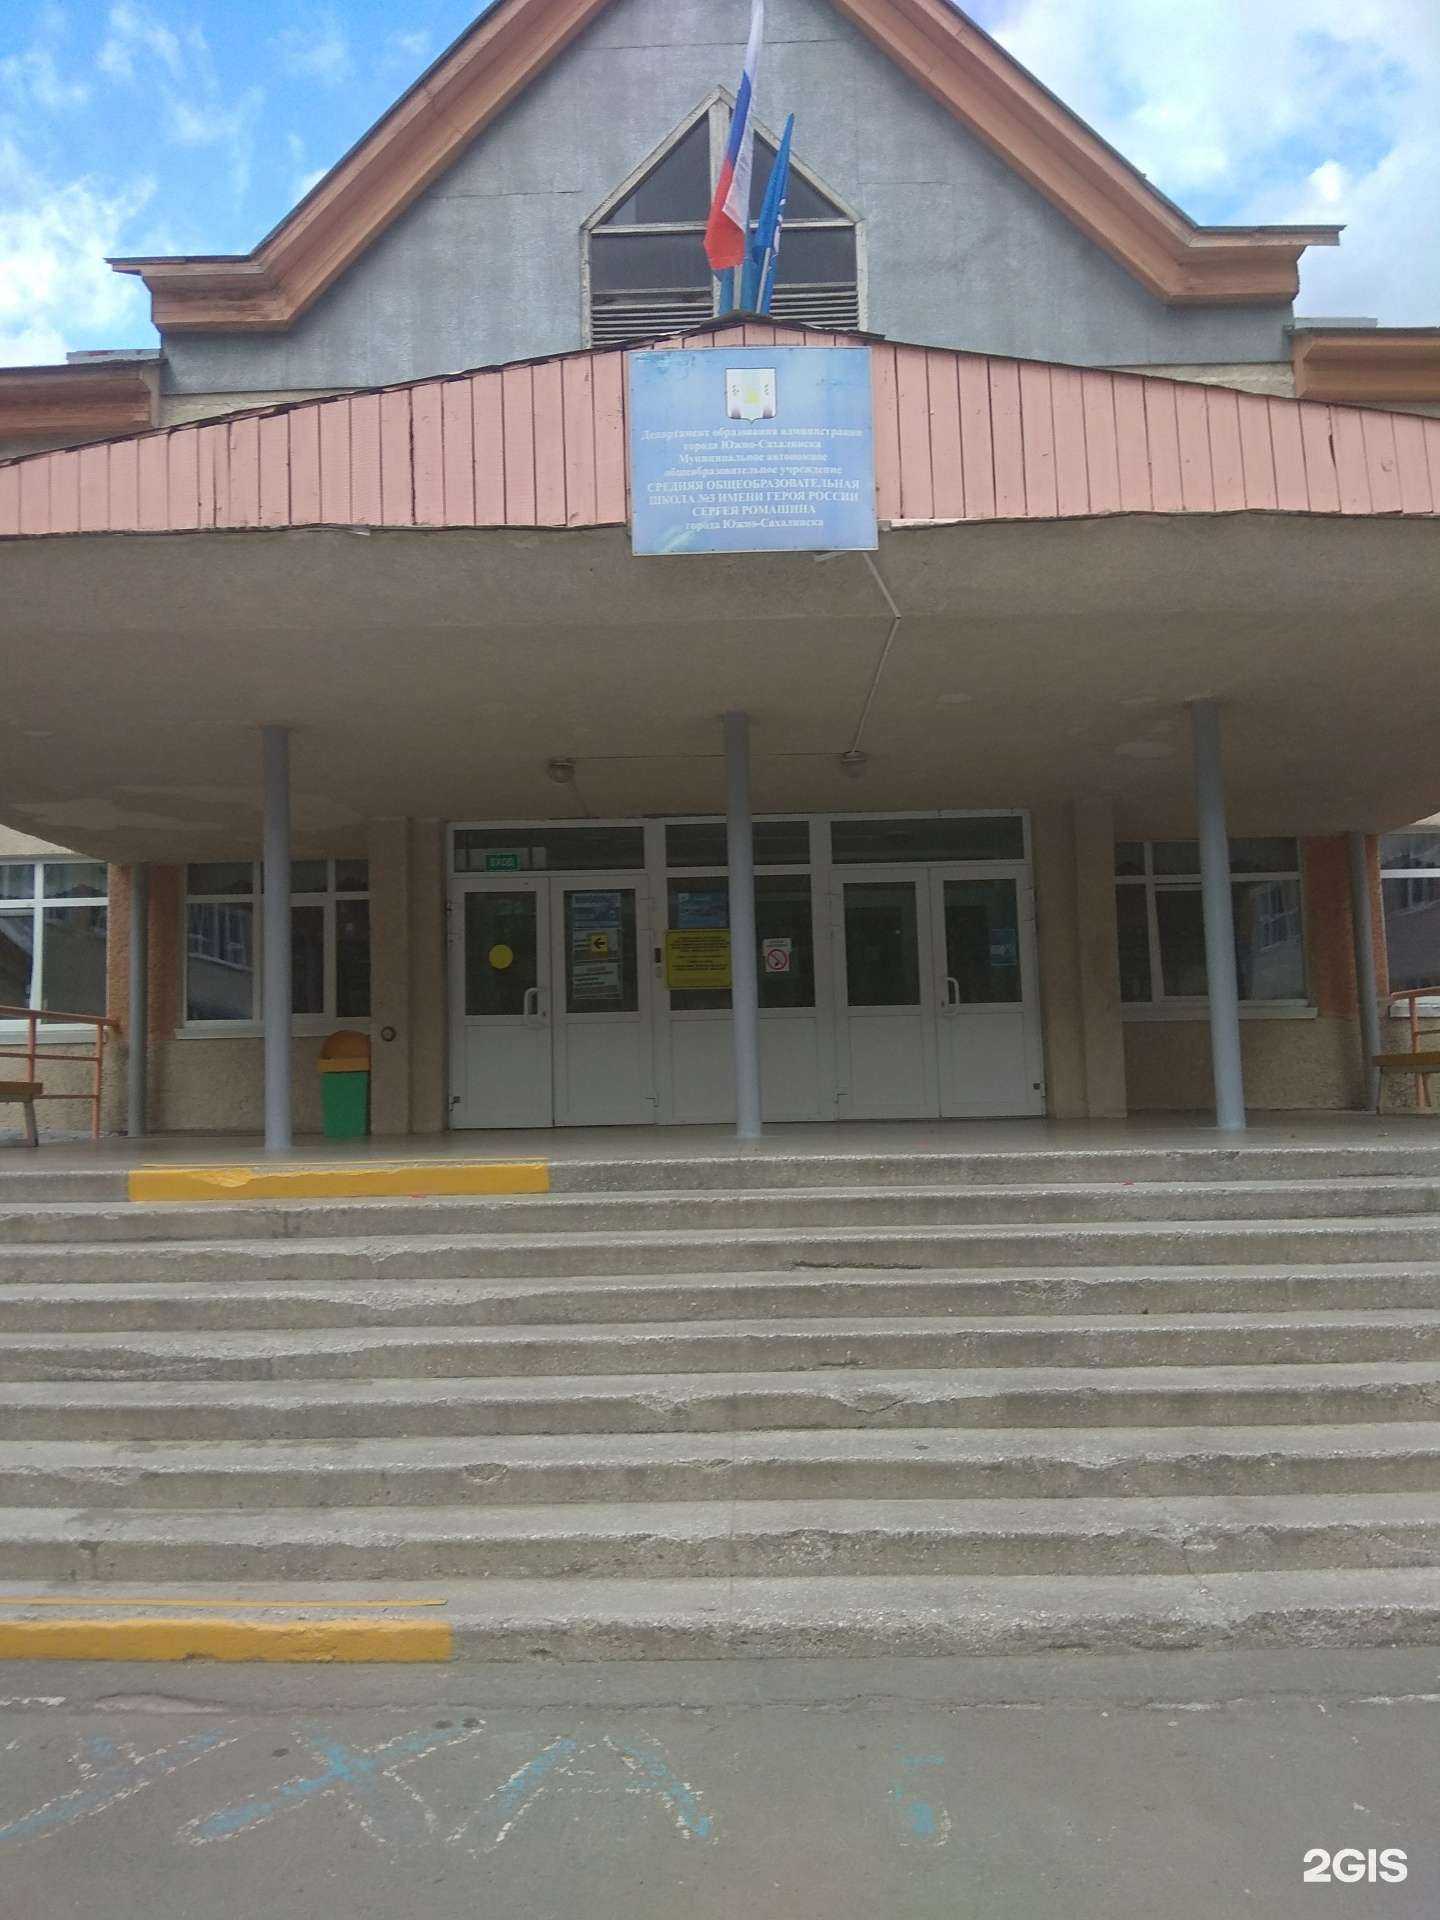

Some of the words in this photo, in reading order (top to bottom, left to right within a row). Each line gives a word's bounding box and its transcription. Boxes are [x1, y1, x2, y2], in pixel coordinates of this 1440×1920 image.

[647, 482, 705, 492] СРЕДНЯЯ
[706, 479, 860, 490] ОБЩЕОБРАЗОВАТЕЛЬНАЯ
[648, 495, 695, 505] ШКОЛА
[719, 492, 764, 502] ИМЕНИ
[766, 491, 805, 501] ГЕРОЯ
[808, 491, 859, 501] РОССИИ
[692, 506, 739, 517] СЕРГЕЯ
[742, 504, 816, 515] РОМАШИНА
[723, 518, 824, 529] Южно-Сахалинска
